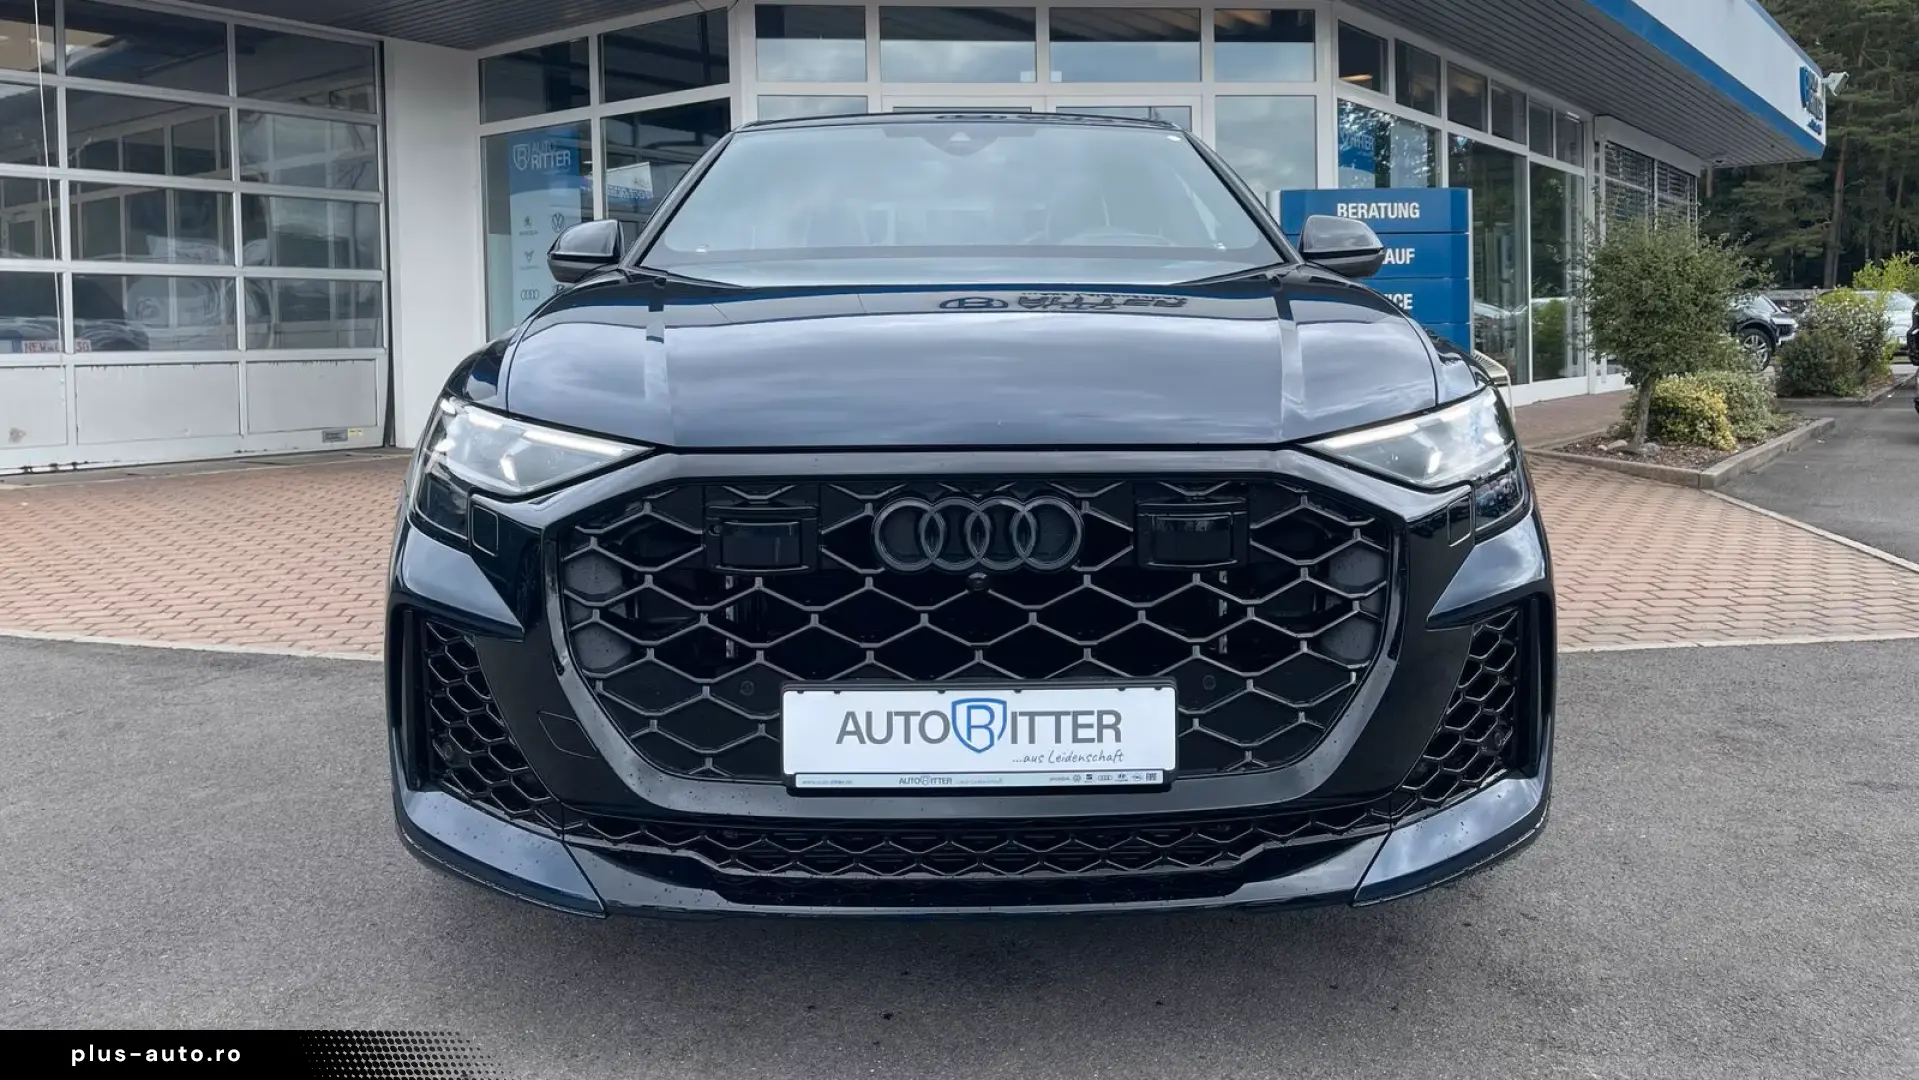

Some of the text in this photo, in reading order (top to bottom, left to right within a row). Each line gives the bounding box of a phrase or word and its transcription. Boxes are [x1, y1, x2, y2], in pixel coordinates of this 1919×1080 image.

[531, 140, 557, 152] AUTO
[531, 149, 571, 170] RITTER
[1337, 202, 1420, 219] BERATUNG
[1382, 247, 1415, 265] AUF
[1048, 749, 1124, 764] Leidenschaft
